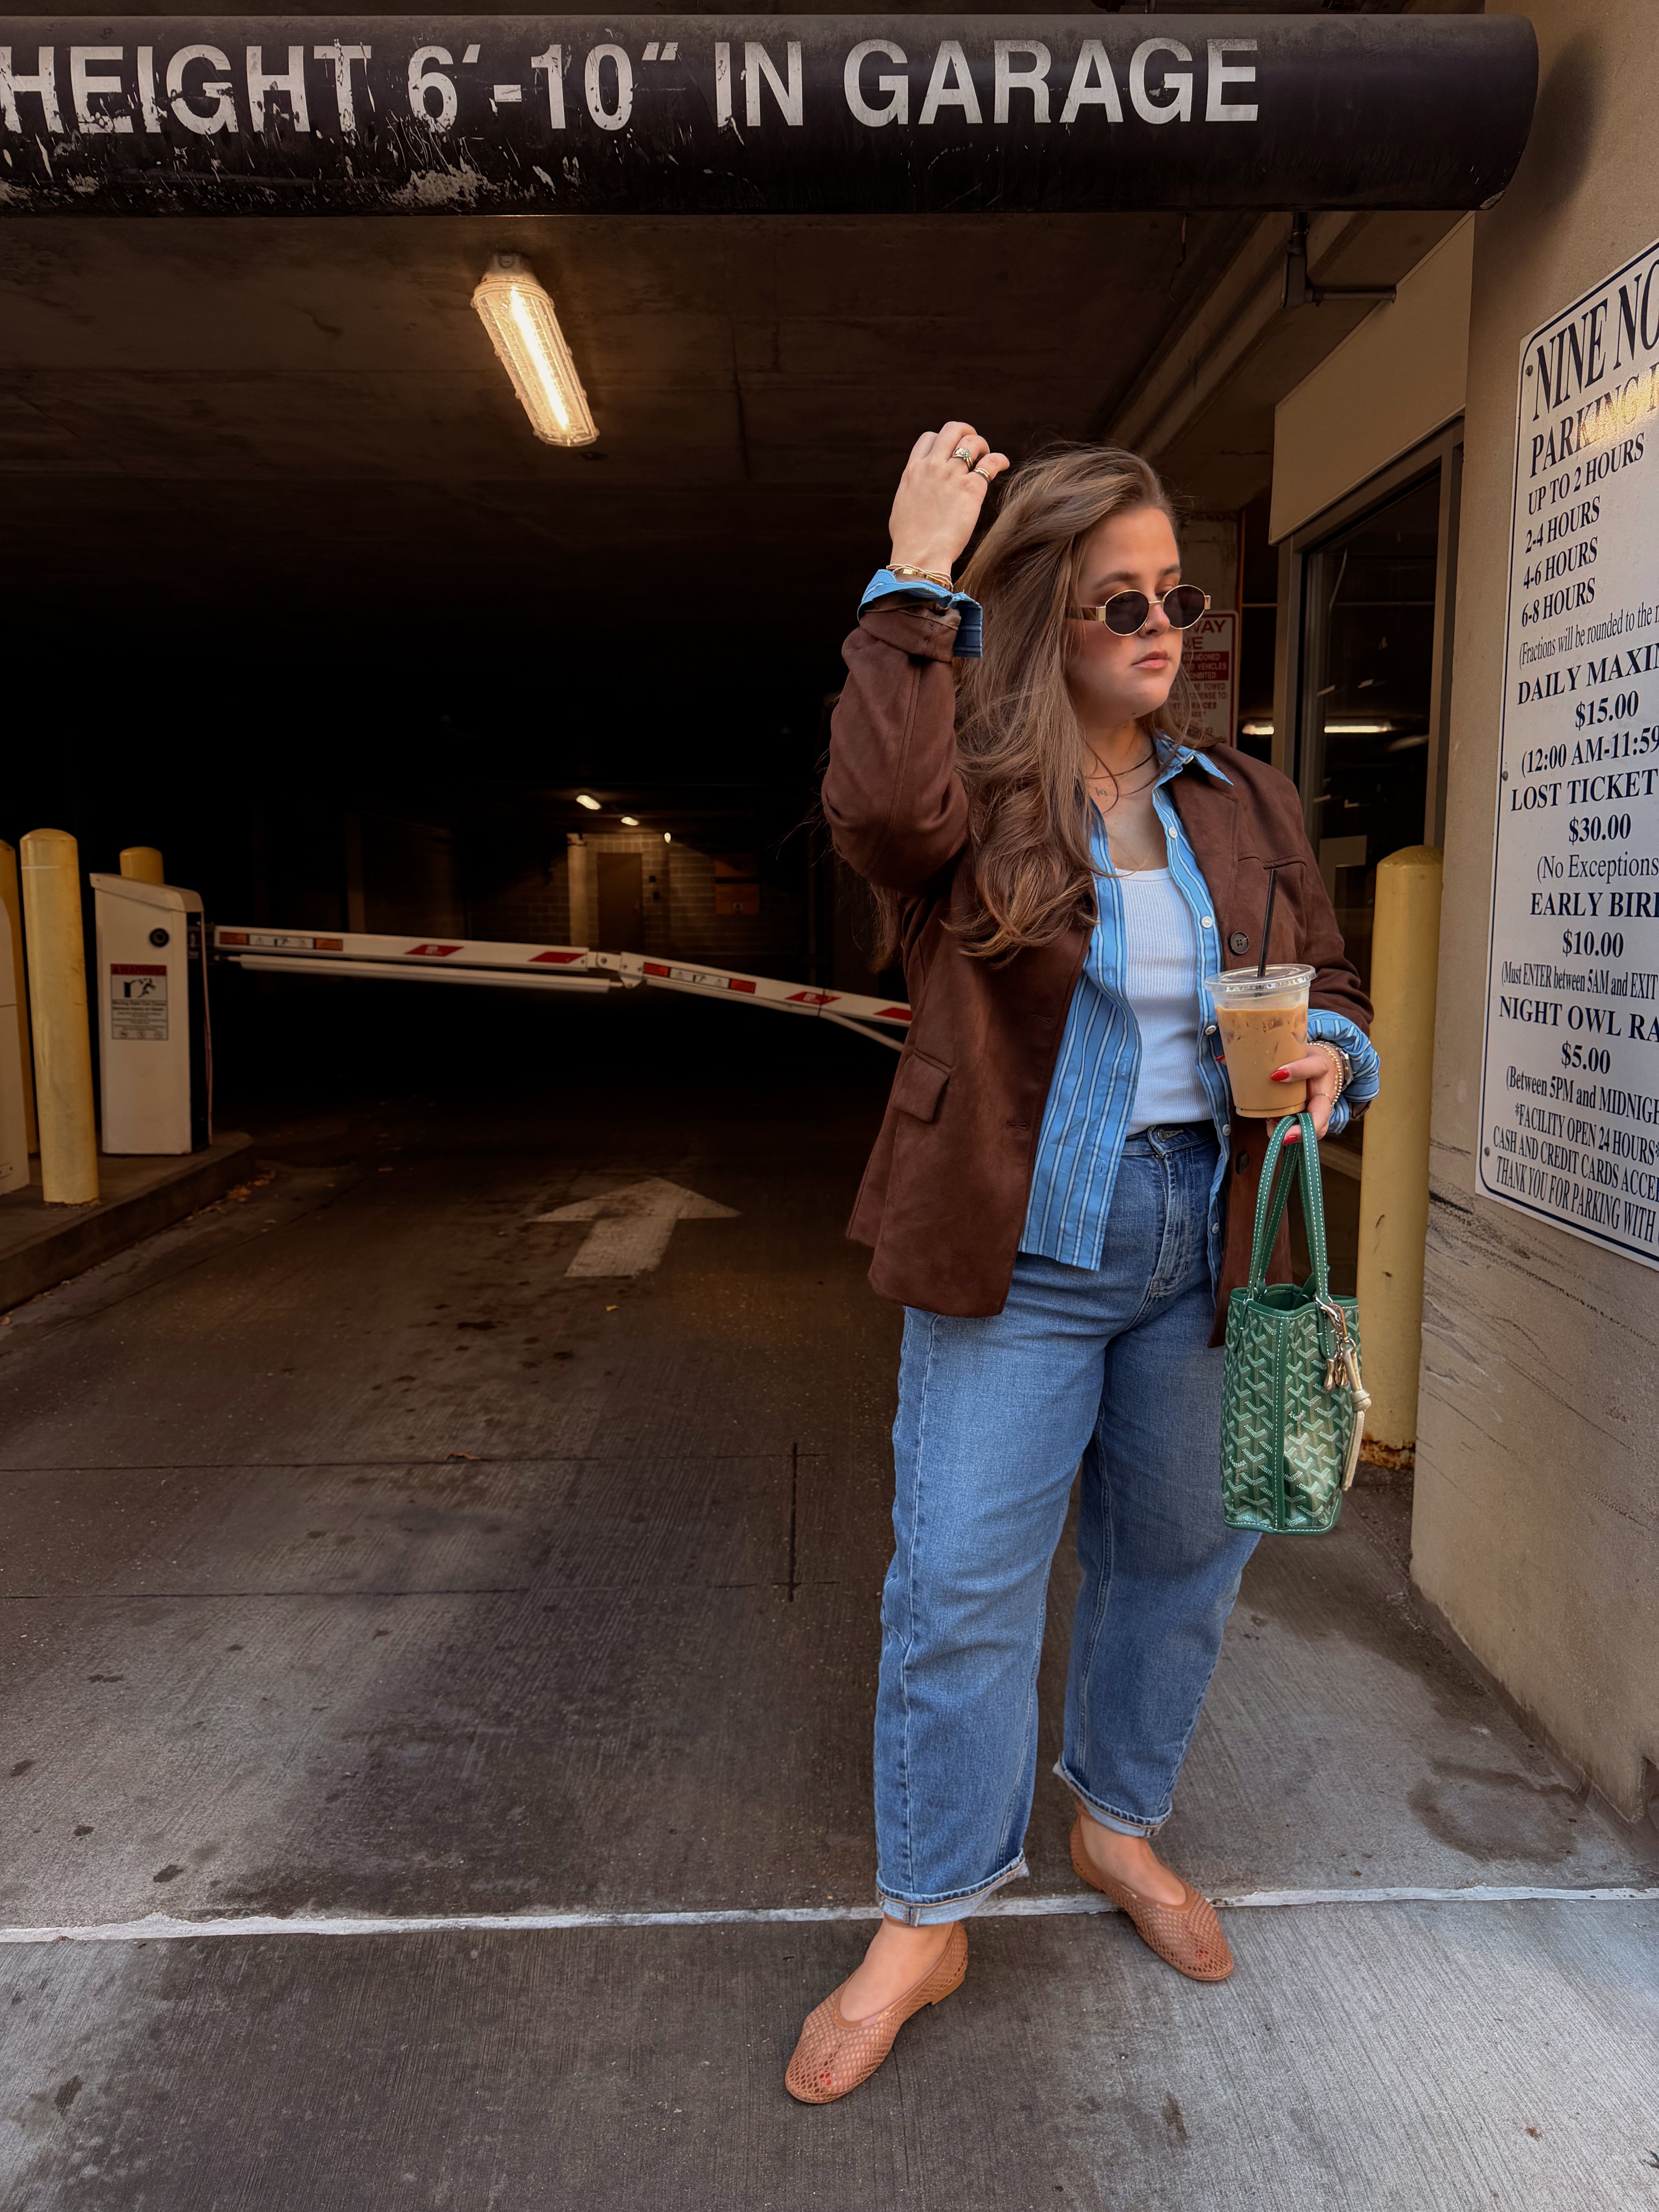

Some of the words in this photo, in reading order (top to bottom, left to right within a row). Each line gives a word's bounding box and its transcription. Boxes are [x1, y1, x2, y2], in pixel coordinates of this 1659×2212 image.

[0, 43, 371, 134] HEIGHT
[715, 41, 802, 128] IN
[843, 38, 1259, 127] GARAGE
[1532, 297, 1608, 422] NINE
[1528, 486, 1546, 515] UP
[1550, 473, 1570, 505] TO
[1573, 466, 1582, 493] 2
[1584, 431, 1645, 487] HOURS
[1525, 523, 1544, 553] 2-4
[1546, 494, 1600, 543] HOURS
[1523, 560, 1542, 589] 4-6
[1544, 535, 1598, 582] HOURS
[1522, 599, 1540, 627] 6-8
[1542, 576, 1595, 620] HOURS
[1519, 636, 1556, 670] (Fractions
[1558, 625, 1573, 653] will
[1575, 624, 1585, 648] be
[1586, 608, 1623, 644] rounded
[1625, 610, 1635, 632] to
[1637, 601, 1652, 628] the
[1517, 664, 1582, 705] DAILY
[1575, 690, 1639, 731] $15.00
[1521, 743, 1567, 779] (12:00
[1570, 725, 1659, 766] AM-11:59
[1510, 782, 1561, 812] LOST
[1567, 768, 1659, 804] TICKET
[1568, 813, 1631, 845] $30.00
[1537, 855, 1564, 884] (No
[1568, 851, 1659, 884] Exceptions
[1529, 892, 1604, 916] EARLY
[1562, 928, 1624, 958] $10.00
[1501, 961, 1522, 986] (Must
[1523, 963, 1552, 988] ENTER
[1554, 966, 1585, 992] between
[1587, 969, 1610, 995] 5AM
[1611, 972, 1628, 997] and
[1630, 973, 1658, 1000] EXIT
[1499, 995, 1563, 1027] NIGHT
[1568, 1005, 1621, 1036] OWL
[1561, 1040, 1611, 1074] $5.00
[1506, 1065, 1547, 1096] (Between
[1550, 1076, 1574, 1103] 5PM
[1576, 1085, 1596, 1109] and
[1493, 1125, 1517, 1154] CASH
[1518, 1134, 1538, 1160] AND
[1541, 1141, 1579, 1174] CREDIT
[1581, 1154, 1619, 1188] CARDS
[1567, 1118, 1597, 1148] OPEN
[1598, 1126, 1610, 1152] 24
[1496, 1156, 1527, 1193] THANK
[1528, 1167, 1548, 1201] YOU
[1548, 1175, 1570, 1210] FOR
[1571, 1183, 1621, 1230] PARKING
[1624, 1201, 1656, 1243] WITH
